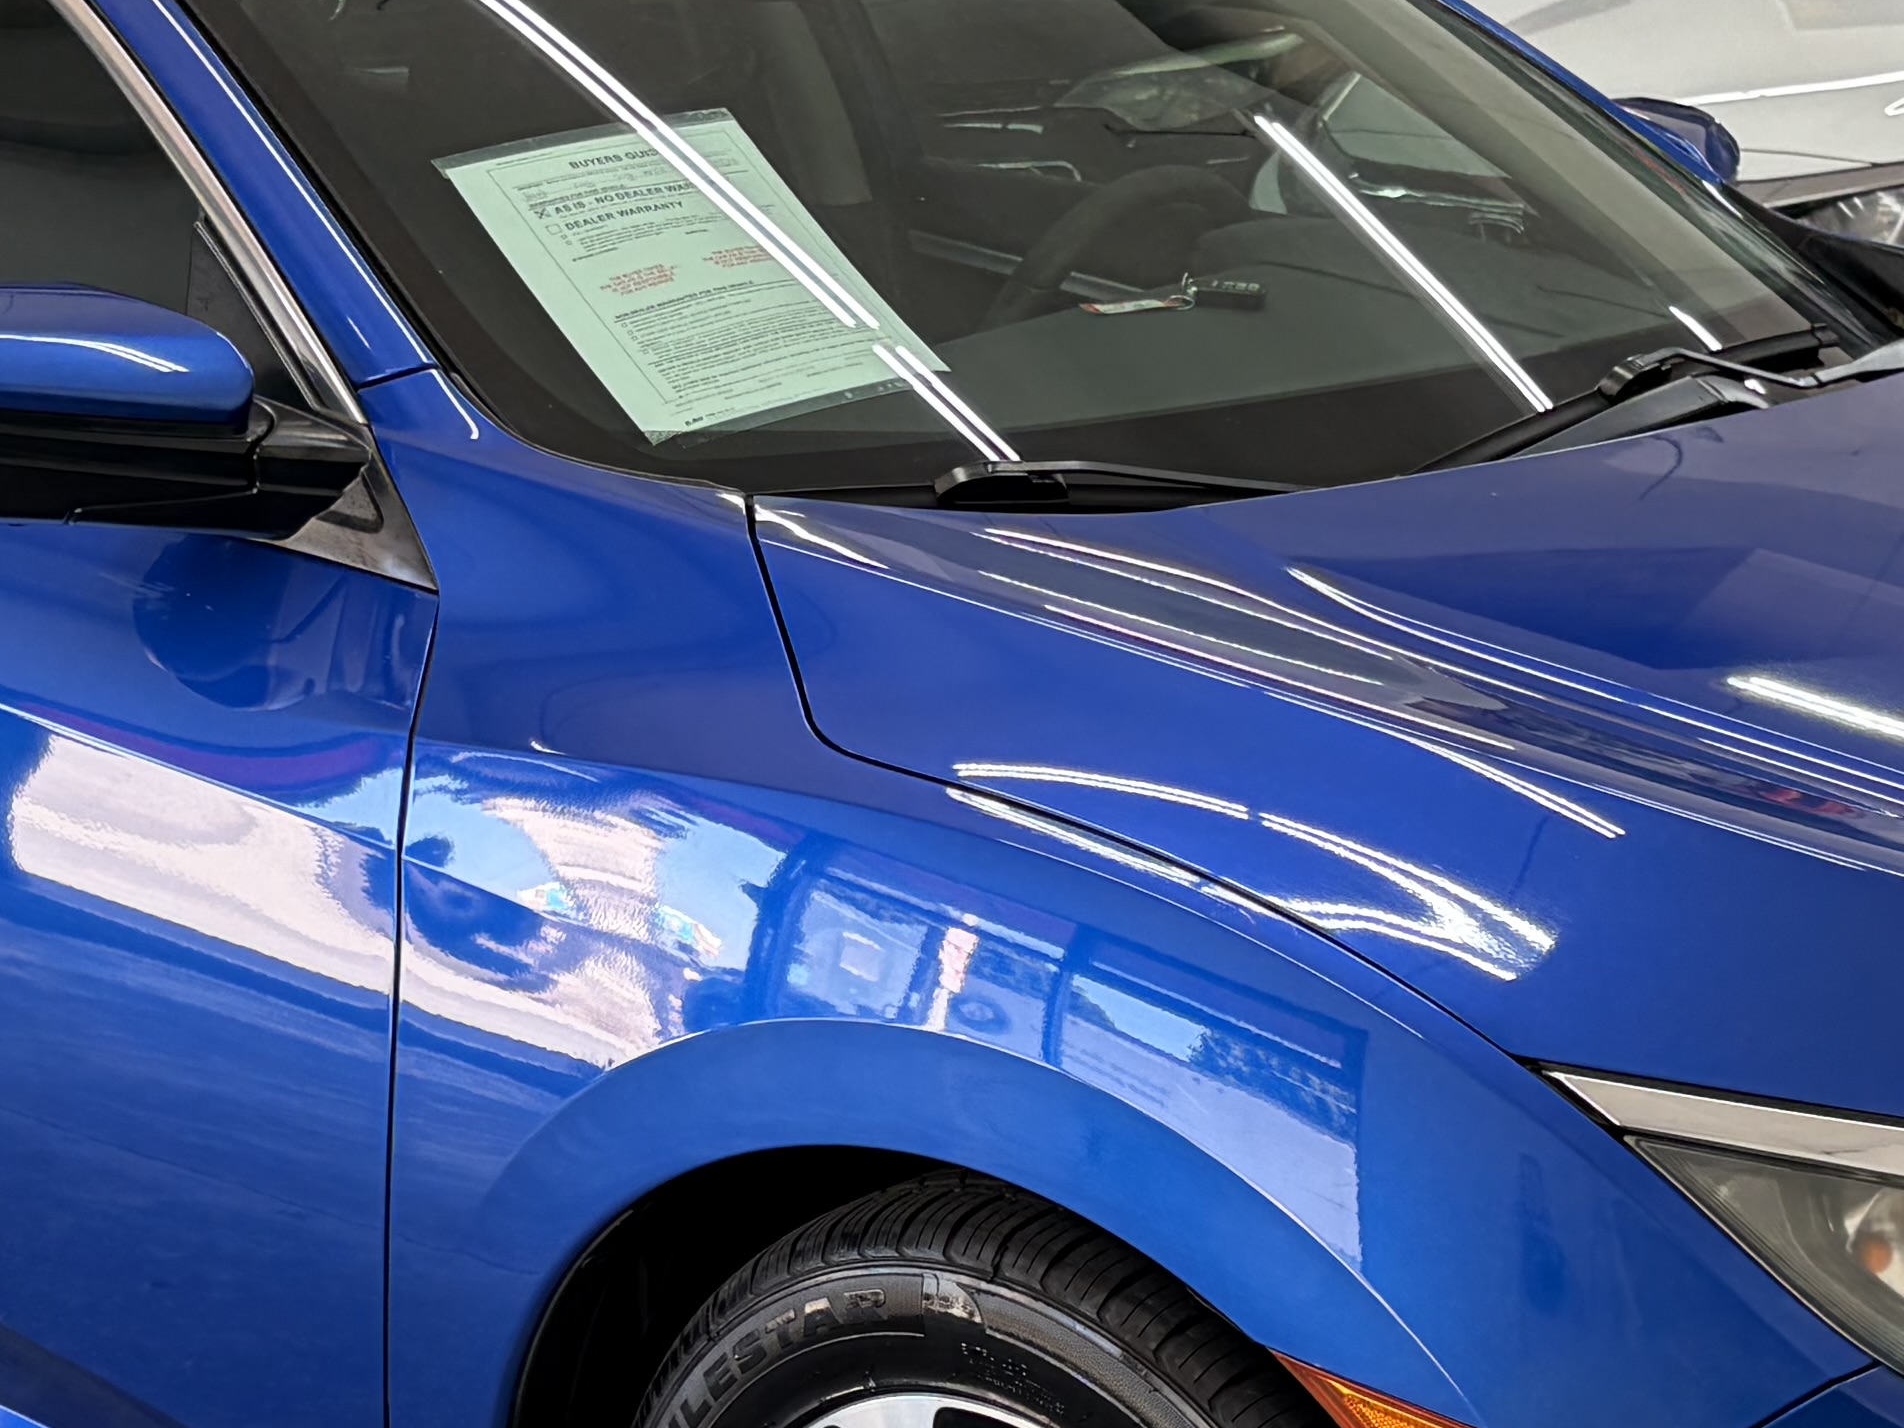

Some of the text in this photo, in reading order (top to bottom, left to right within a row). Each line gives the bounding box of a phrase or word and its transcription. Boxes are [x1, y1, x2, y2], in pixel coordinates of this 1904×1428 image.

[568, 152, 624, 170] BUYERS
[554, 201, 573, 215] AS
[573, 199, 586, 210] IS
[595, 193, 614, 205] NO
[614, 185, 664, 202] DEALER
[565, 200, 684, 231] DEALER WARRANTY
